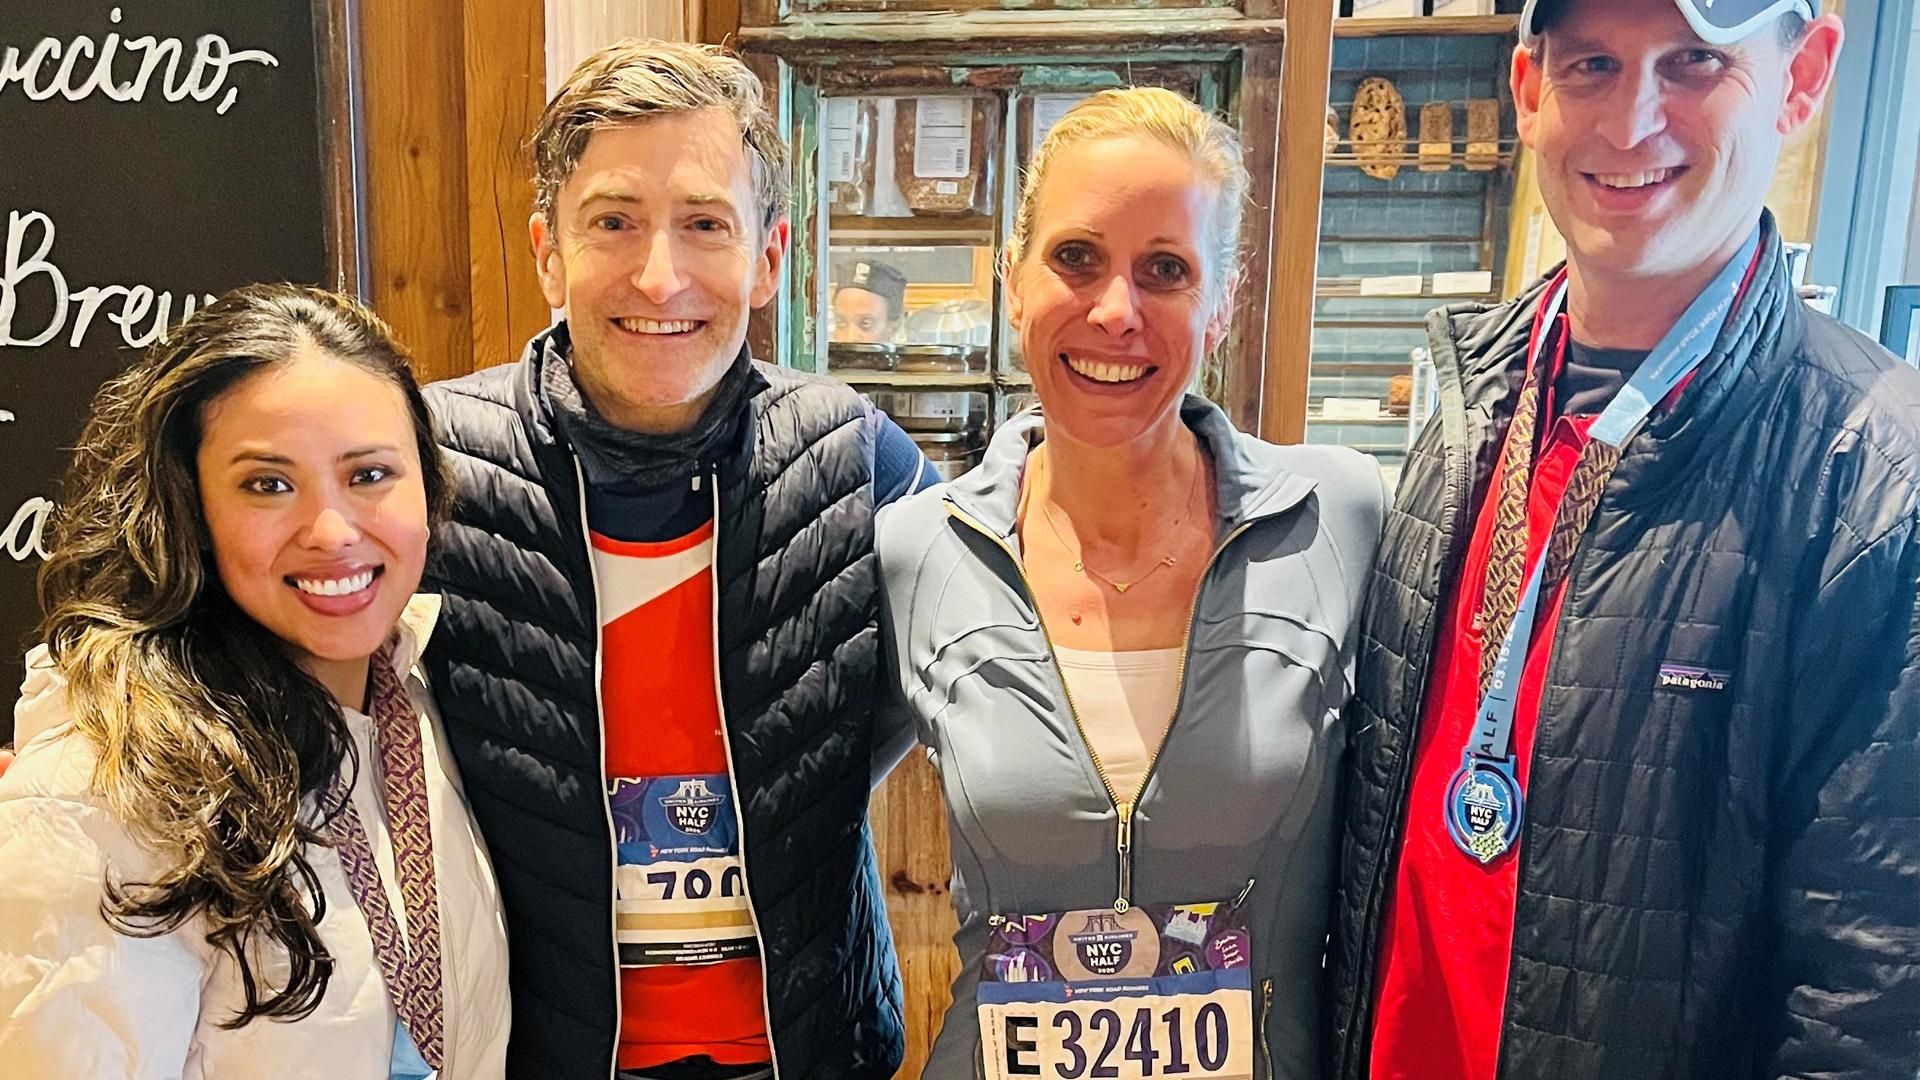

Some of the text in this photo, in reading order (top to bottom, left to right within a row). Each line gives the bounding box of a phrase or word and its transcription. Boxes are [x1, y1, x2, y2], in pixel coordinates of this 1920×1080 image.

[1662, 675, 1723, 689] patagonia
[676, 806, 709, 819] NYC
[1470, 805, 1493, 819] NYC
[678, 818, 707, 828] HALF
[1086, 943, 1122, 957] NYC
[1090, 956, 1120, 967] HALF
[1005, 1016, 1041, 1075] E
[1052, 1002, 1229, 1079] 32410
